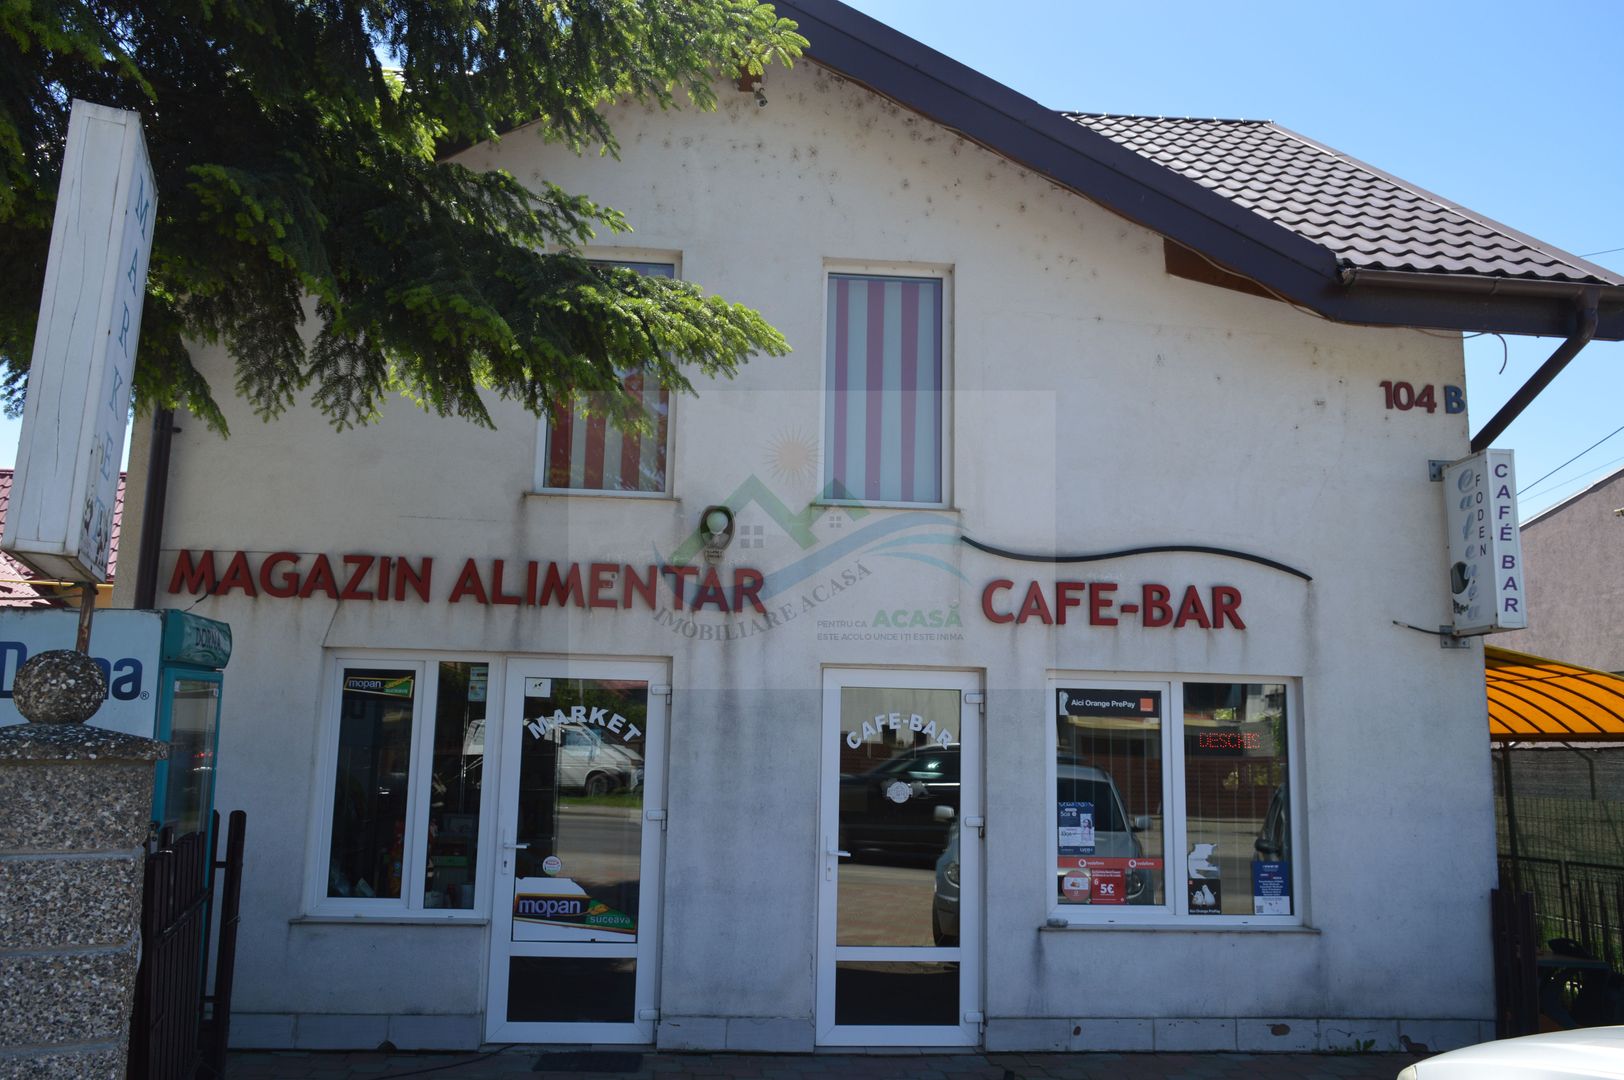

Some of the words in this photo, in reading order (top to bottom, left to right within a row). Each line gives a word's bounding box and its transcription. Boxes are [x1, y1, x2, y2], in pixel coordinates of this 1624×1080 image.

[92, 173, 150, 544] MARKET
[1379, 381, 1437, 414] 104
[1444, 384, 1465, 414] B
[1475, 473, 1487, 556] FODEN
[1494, 463, 1513, 541] CAFÉ
[168, 549, 433, 603] MAGAZIN
[448, 557, 767, 613] ALIMENTAR
[1502, 555, 1518, 613] BAR
[981, 579, 1246, 630] CAFE-BAR
[349, 679, 382, 690] mopan
[527, 705, 642, 742] MARKET
[1071, 699, 1084, 707] Aici
[1085, 700, 1110, 709] Orange
[1111, 700, 1136, 710] PrePay
[846, 712, 953, 750] CAFE-BAR
[519, 899, 582, 917] mopan
[590, 914, 631, 925] suceava
